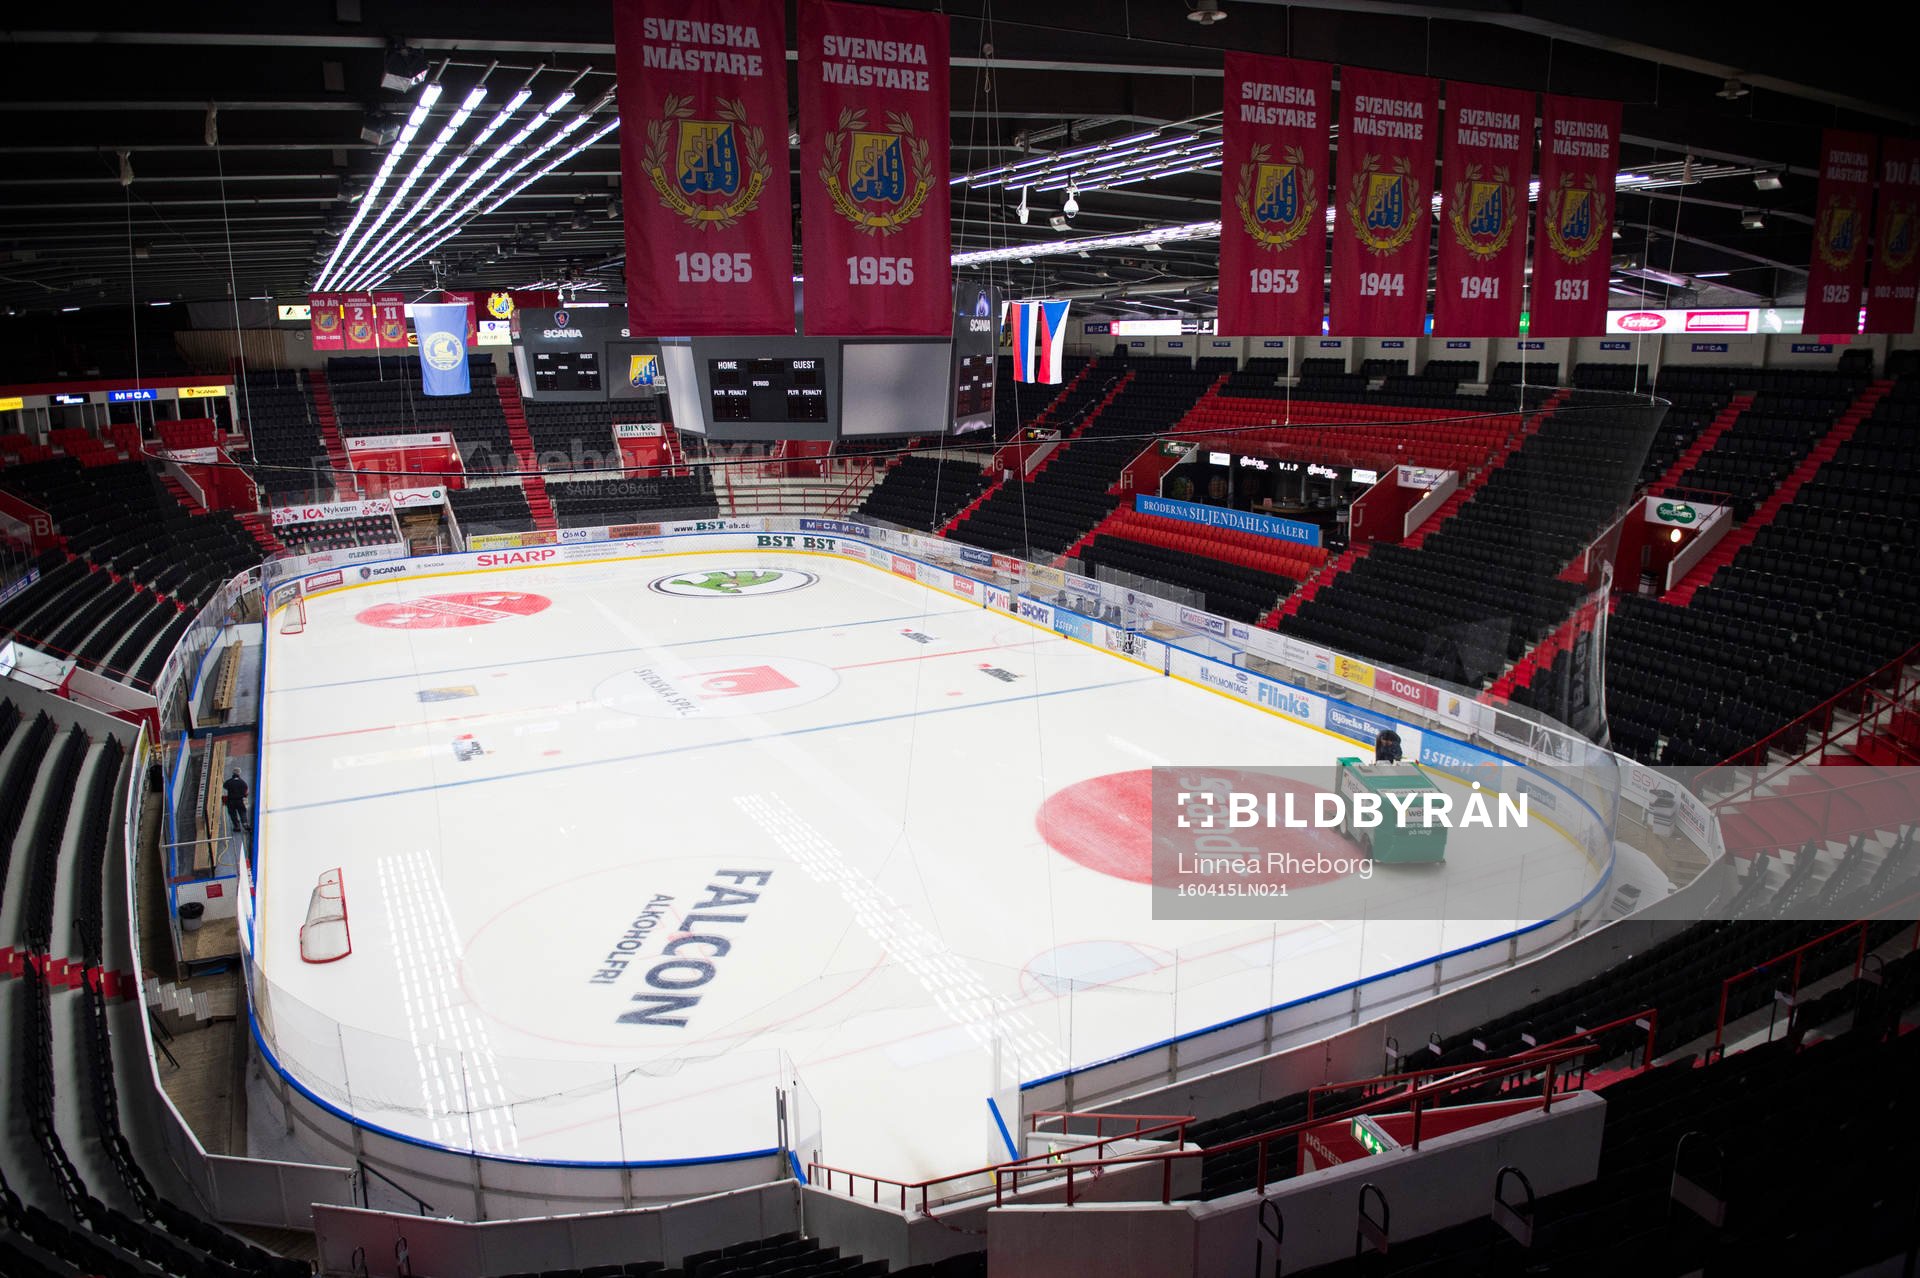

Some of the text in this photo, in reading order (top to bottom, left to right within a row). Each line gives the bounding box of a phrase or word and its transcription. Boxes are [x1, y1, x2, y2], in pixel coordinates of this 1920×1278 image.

[643, 17, 760, 49] SVENSKA
[643, 43, 763, 77] MÄSTARE
[823, 35, 928, 65] SVENSKA
[822, 59, 929, 92] MÄSTARE
[1241, 82, 1316, 107] SVENSKA
[1240, 102, 1317, 129] MÄSTARE
[1355, 95, 1424, 119] SVENSKA
[1353, 115, 1423, 141] MÄSTARE
[1459, 108, 1520, 131] SVENSKA
[1554, 119, 1609, 141] SVENSKA
[1457, 126, 1519, 151] MÄSTARE
[1553, 138, 1609, 160] MÄSTARE
[675, 252, 752, 283] 1985
[847, 256, 914, 286] 1956
[1250, 268, 1300, 294] 1953
[1360, 273, 1405, 297] 1944
[1460, 276, 1499, 300] 1941
[1554, 279, 1589, 301] 1931
[327, 297, 339, 307] ÅR
[1822, 285, 1849, 304] 1925
[354, 307, 364, 321] 2
[384, 307, 397, 320] 11
[543, 328, 583, 338] SCANIA
[970, 319, 991, 332] SCANIA
[718, 360, 815, 370] HOME GUEST
[302, 505, 357, 520] ICA Nykvarn
[1143, 500, 1309, 540] BRÖDERNA SILJENDAHLS MÅLERI
[33, 518, 50, 536] B
[757, 535, 796, 547] BST
[803, 537, 836, 550] BST
[477, 549, 556, 567] SHARP
[373, 565, 406, 576] SCANIA
[996, 591, 1049, 624] INTRSPORT
[1257, 681, 1310, 719] Flinks
[1391, 679, 1421, 699] TOOLS
[1332, 709, 1362, 731] Björcks
[1423, 748, 1431, 760] 3
[1431, 752, 1459, 769] STEP
[589, 893, 675, 985] ALKOHOLFRI
[614, 869, 773, 1029] FALCON
